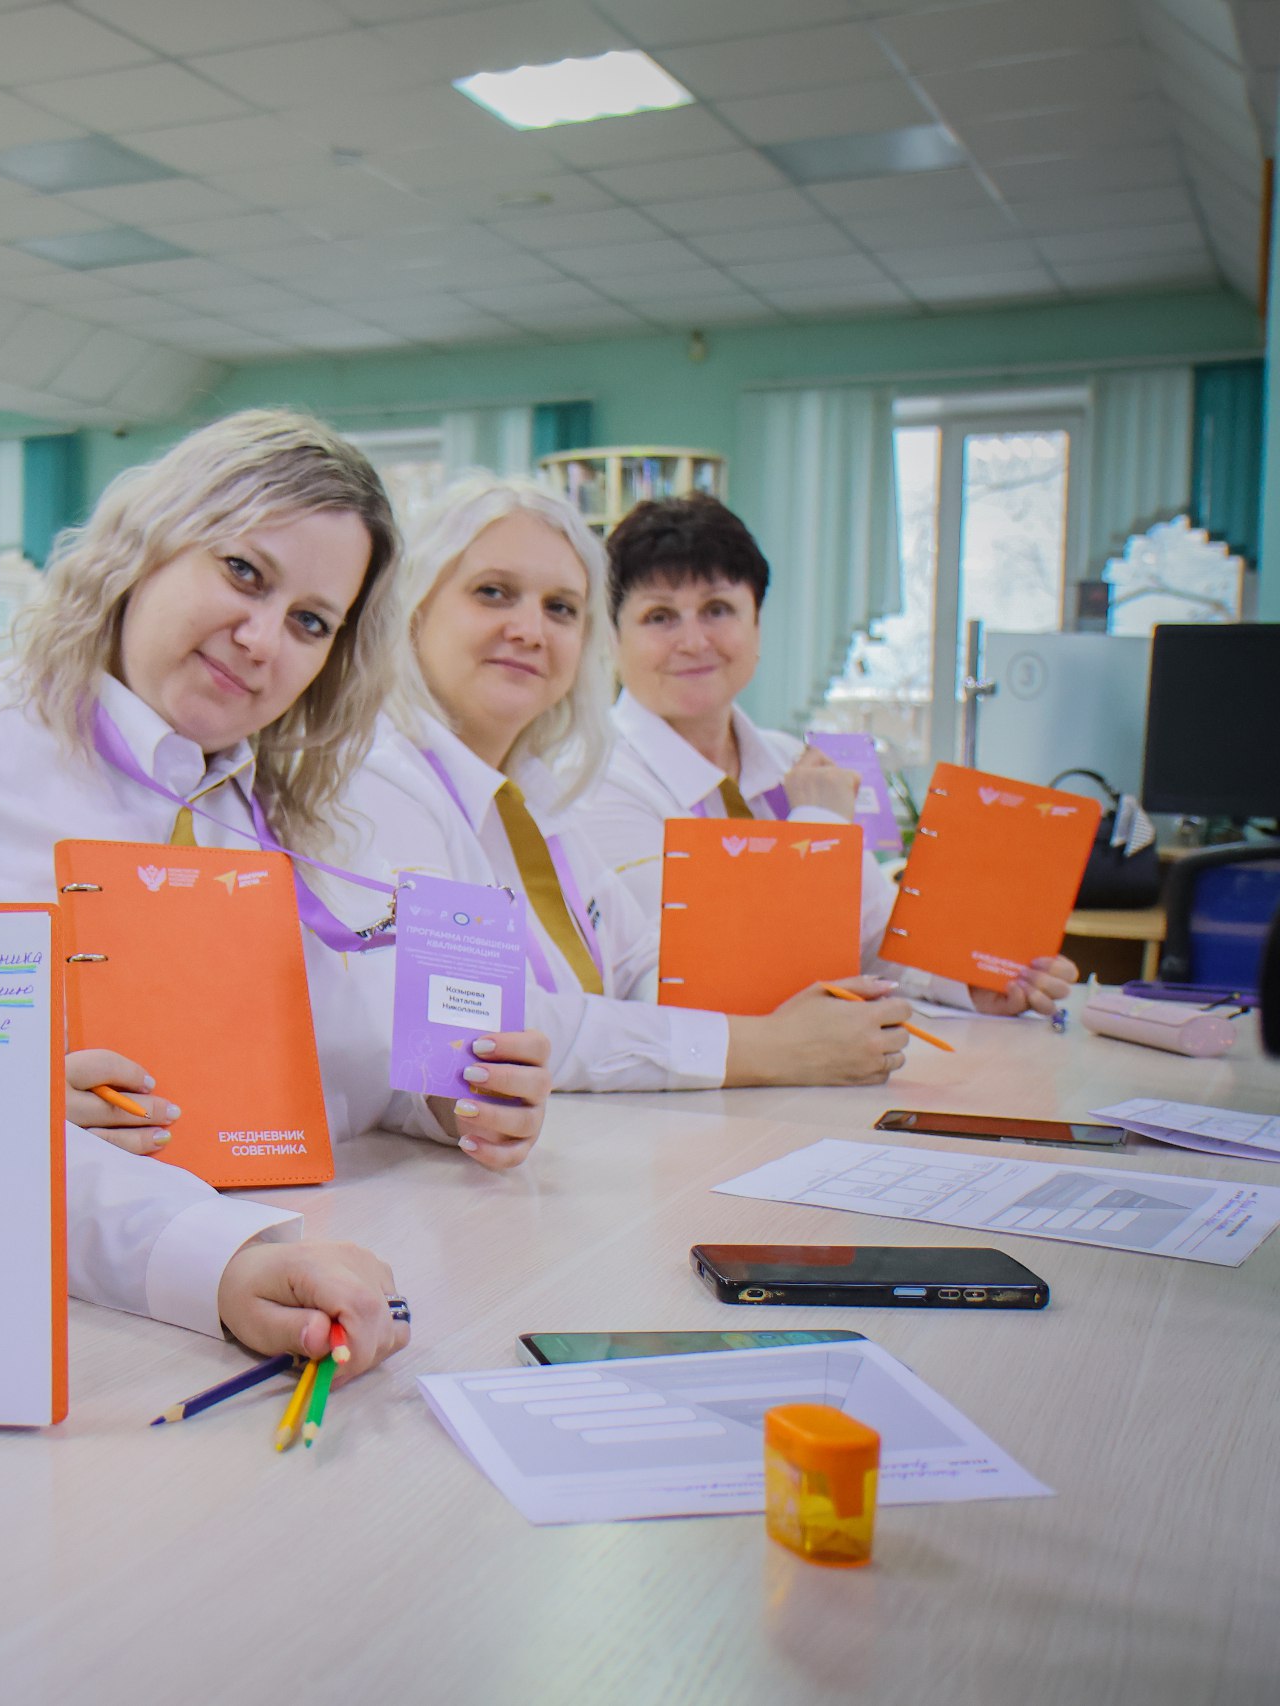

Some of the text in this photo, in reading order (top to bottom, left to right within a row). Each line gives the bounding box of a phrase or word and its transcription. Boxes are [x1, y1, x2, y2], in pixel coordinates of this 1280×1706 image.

[406, 925, 520, 952] ПРОГРАММА ПОВЫШЕНИЯ
[426, 938, 500, 958] КВАЛИФИКАЦИИ
[445, 985, 486, 999] Козырева
[449, 995, 482, 1007] Наталья
[442, 1002, 490, 1016] Николаевна
[219, 1130, 305, 1143] ЕЖЕДНЕВНИК
[232, 1144, 307, 1156] СОВЕТНИКА
